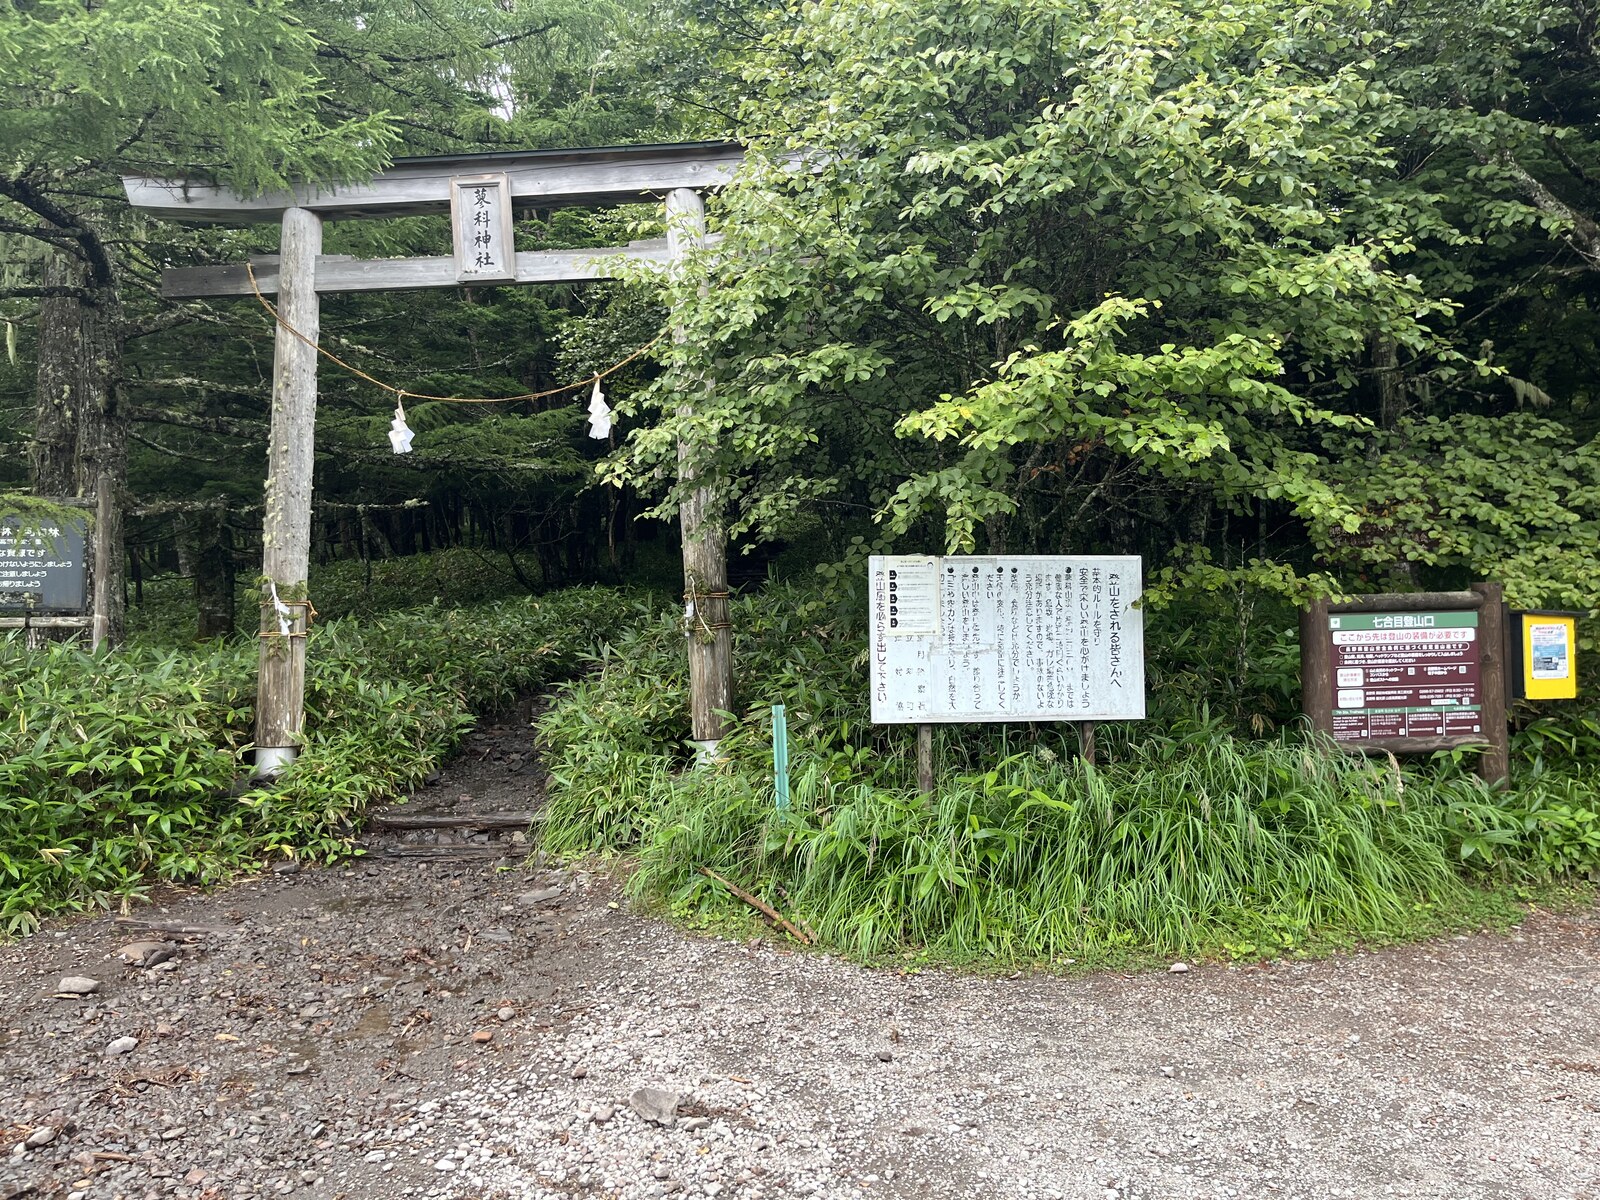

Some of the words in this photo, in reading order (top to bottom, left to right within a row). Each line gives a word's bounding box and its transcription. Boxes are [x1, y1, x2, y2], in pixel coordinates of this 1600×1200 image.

[473, 188, 495, 268] 蓼科神社
[1373, 615, 1435, 628] 七合目登山口
[1340, 631, 1468, 642] ここから先は登山の装備が必要です
